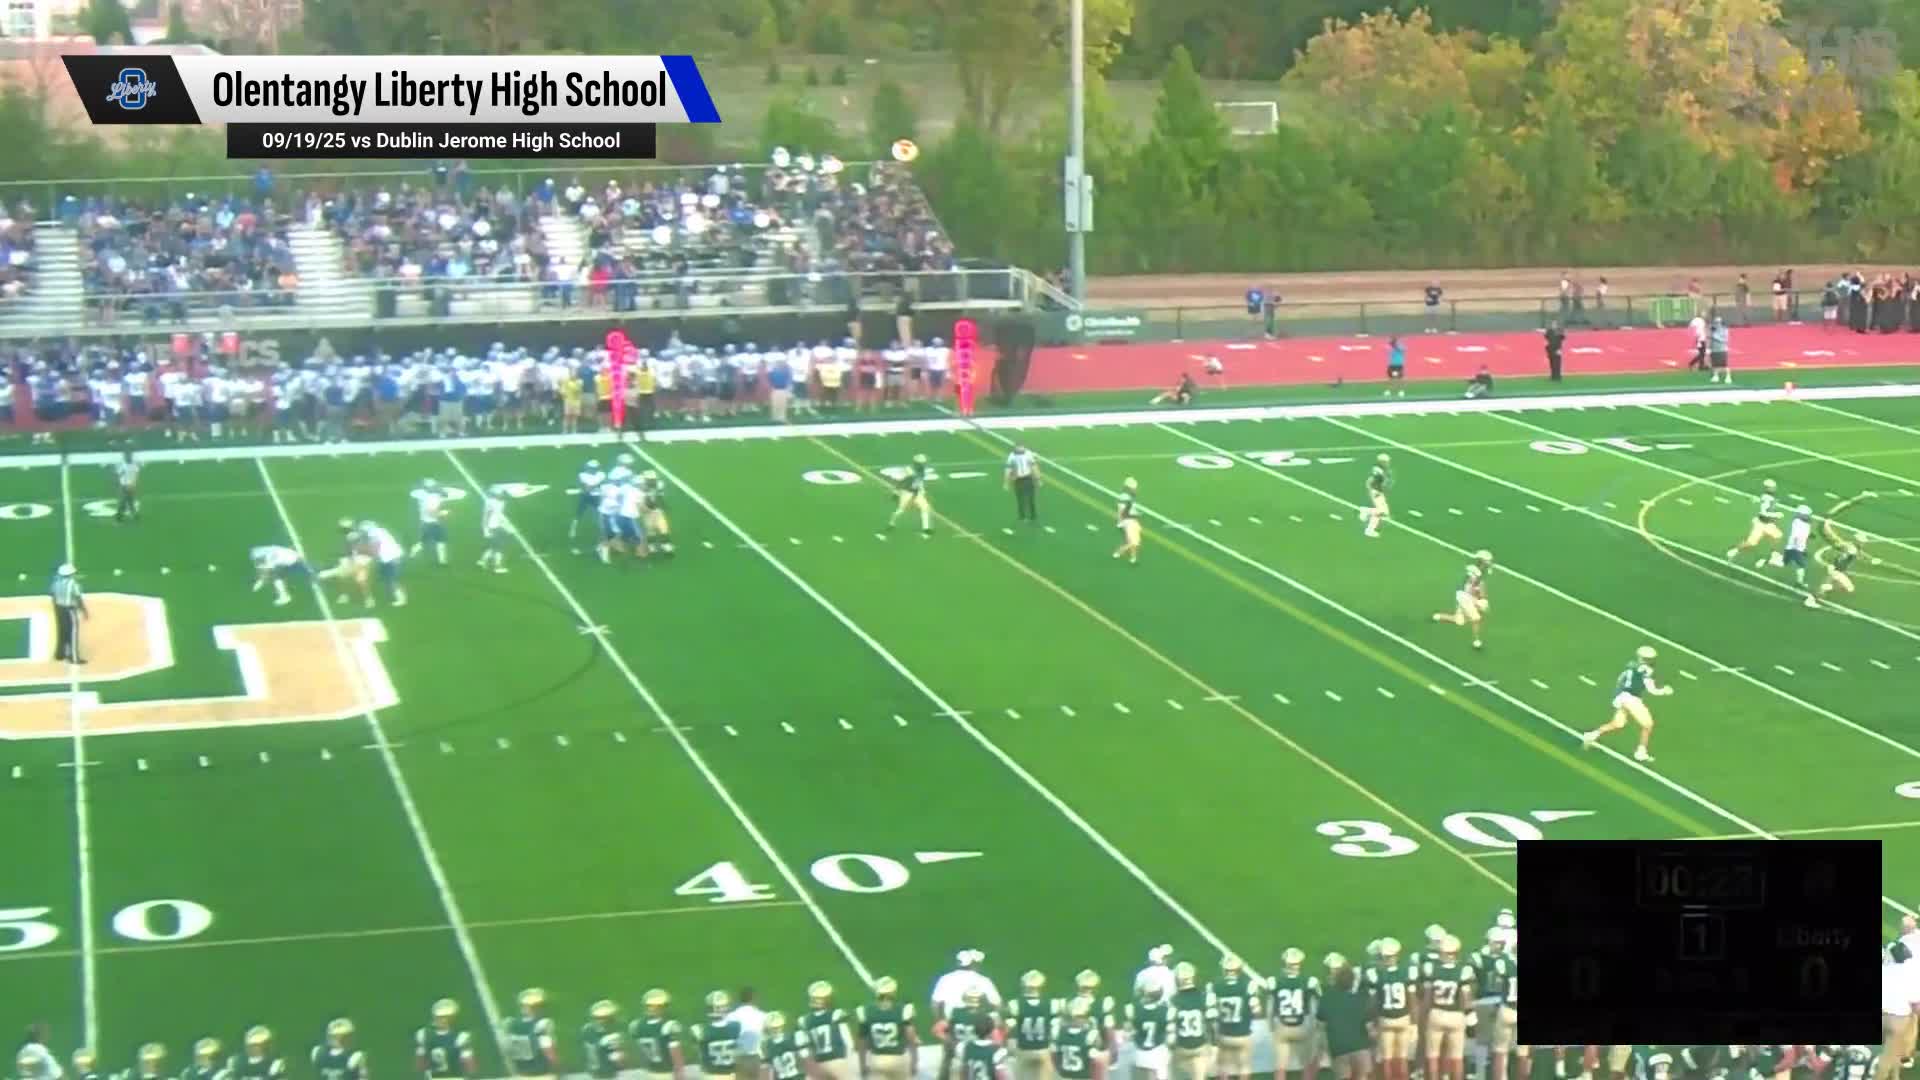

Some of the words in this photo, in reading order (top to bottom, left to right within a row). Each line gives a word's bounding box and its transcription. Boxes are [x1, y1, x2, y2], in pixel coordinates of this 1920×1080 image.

[1315, 811, 1544, 858] 30
[674, 853, 910, 903] 40
[0, 899, 213, 951] 50
[1277, 988, 1304, 1016] 24
[1382, 981, 1406, 1010] 19
[1433, 979, 1458, 1005] 27
[1177, 1009, 1202, 1038] 33
